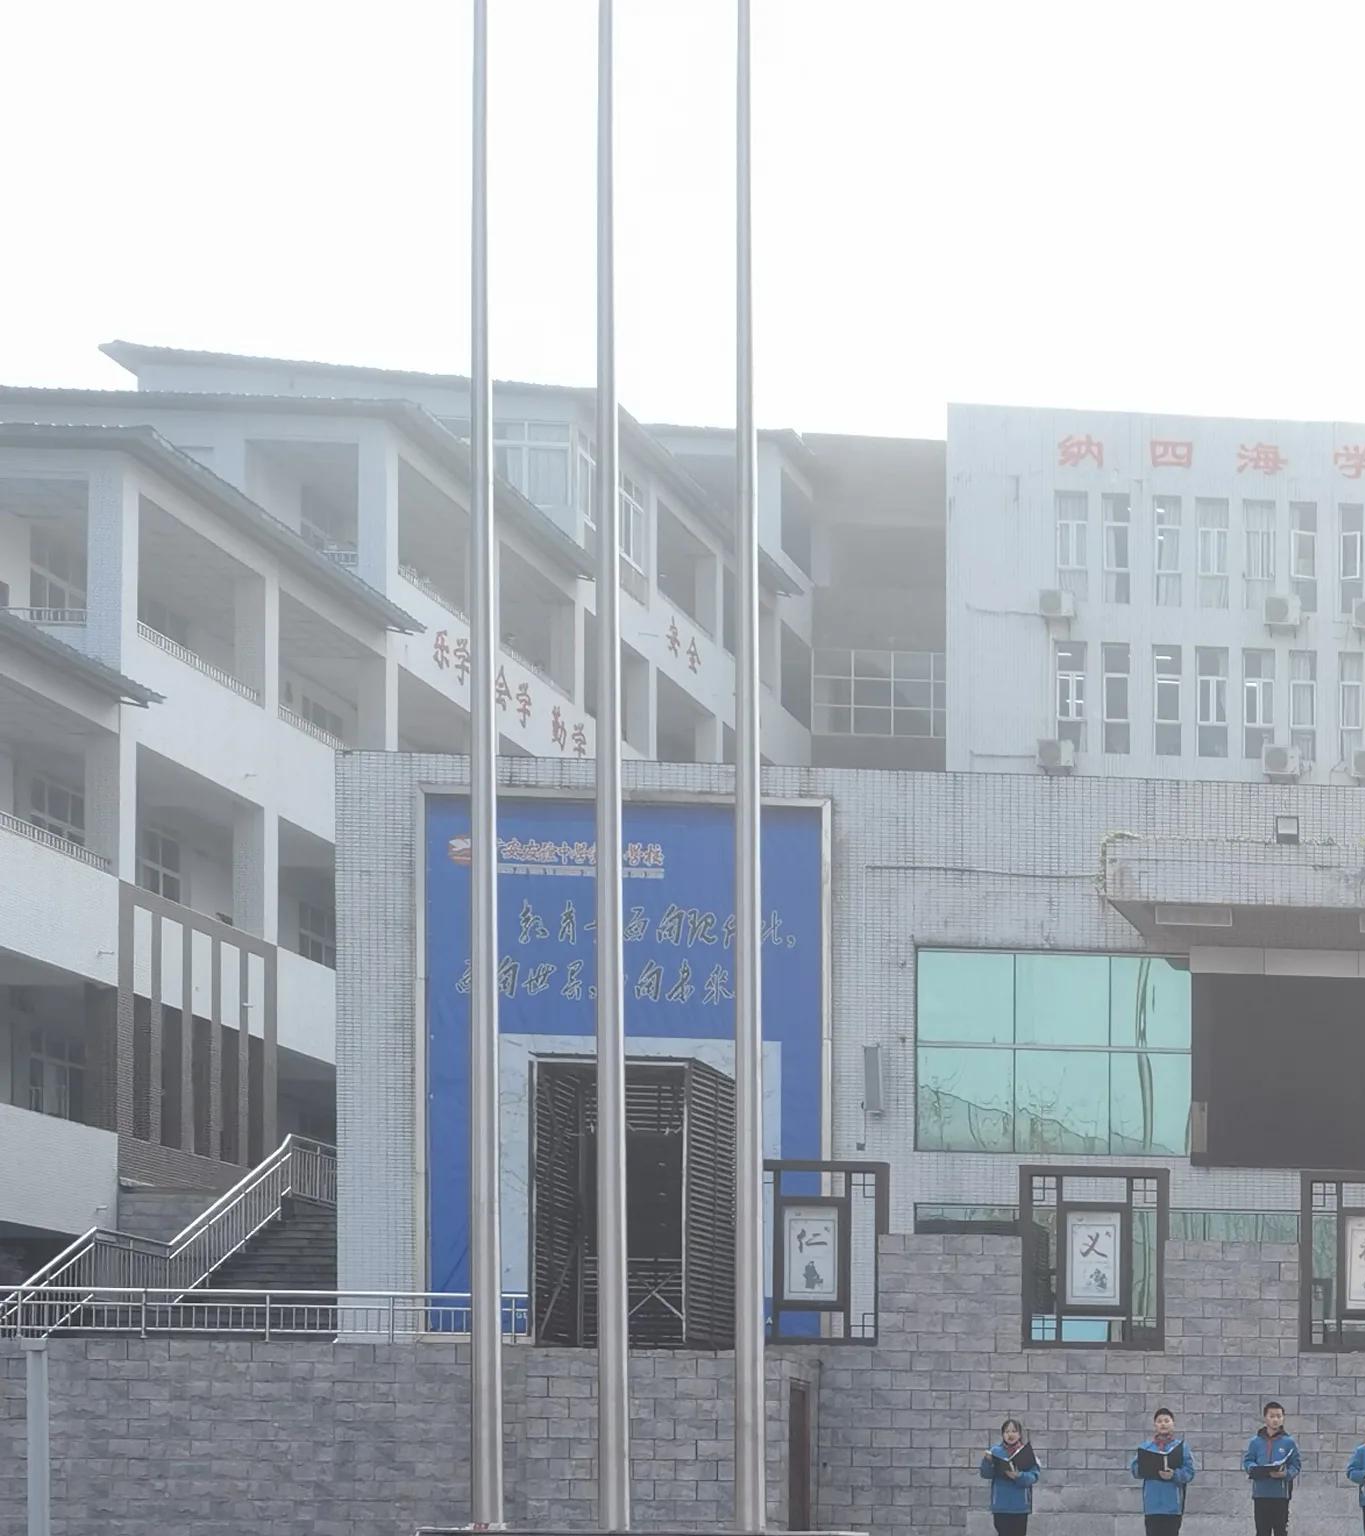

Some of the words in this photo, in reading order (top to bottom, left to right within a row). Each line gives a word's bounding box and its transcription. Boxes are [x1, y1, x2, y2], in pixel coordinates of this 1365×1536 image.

[665, 616, 702, 674] 安全
[796, 1228, 828, 1253] 仁
[1080, 1232, 1108, 1258] 义
